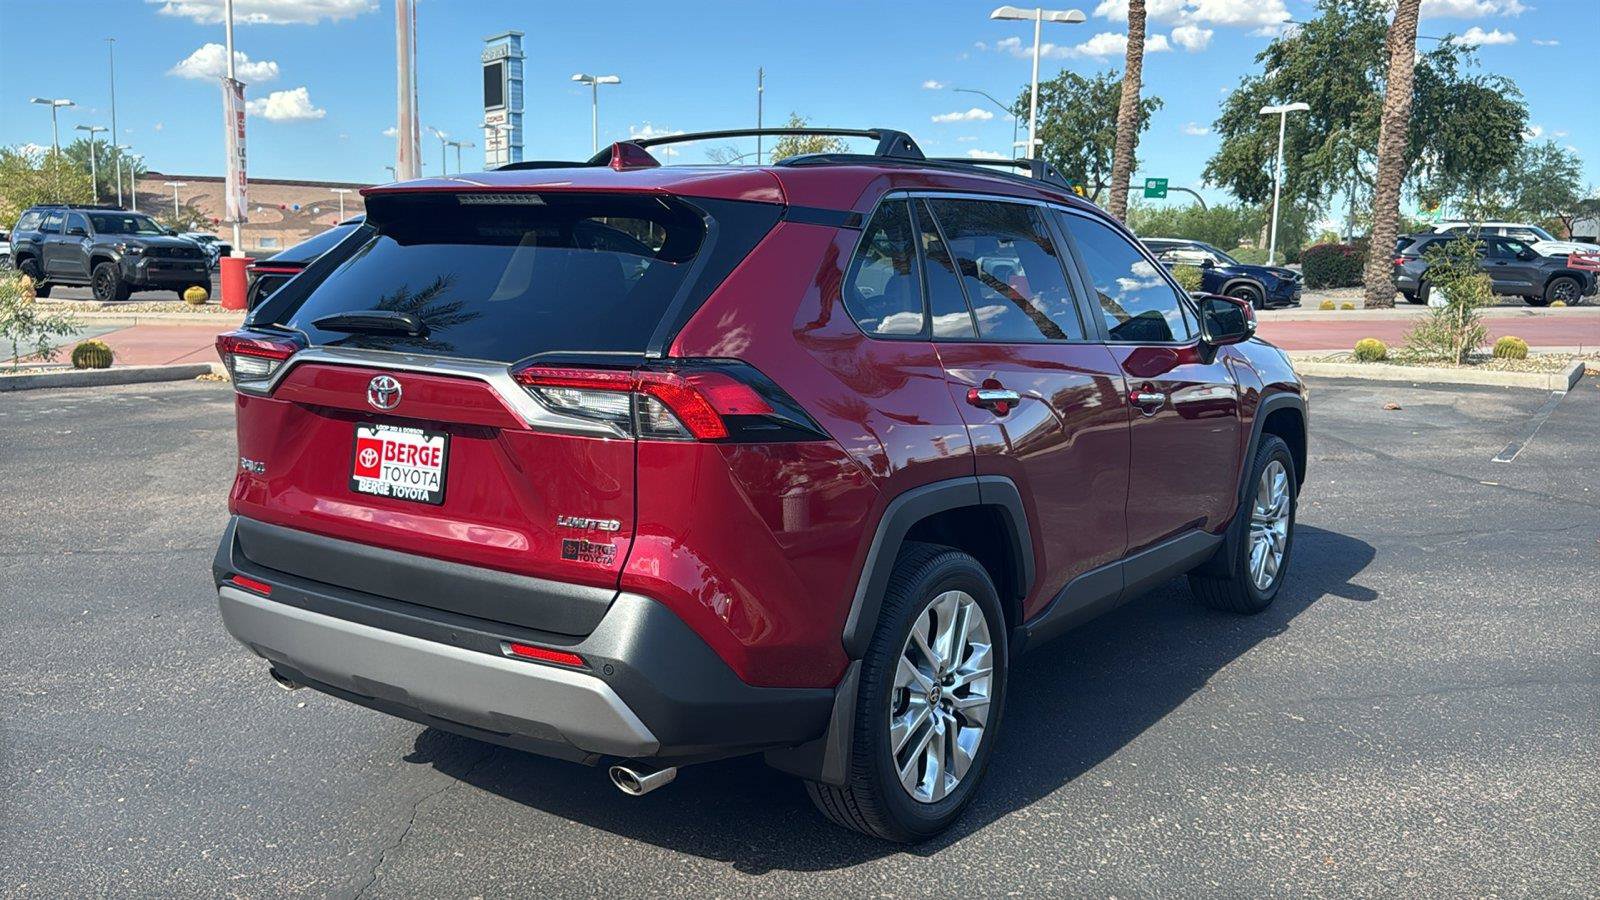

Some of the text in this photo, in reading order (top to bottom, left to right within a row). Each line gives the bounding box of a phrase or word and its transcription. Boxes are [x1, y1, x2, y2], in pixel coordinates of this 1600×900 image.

[385, 440, 441, 467] BERGE
[383, 466, 439, 488] TOYOTA
[358, 480, 430, 501] BERGE TOYOTA
[556, 515, 621, 531] LIMITED
[579, 539, 617, 557] BERGE
[578, 553, 614, 565] TOYOTA
